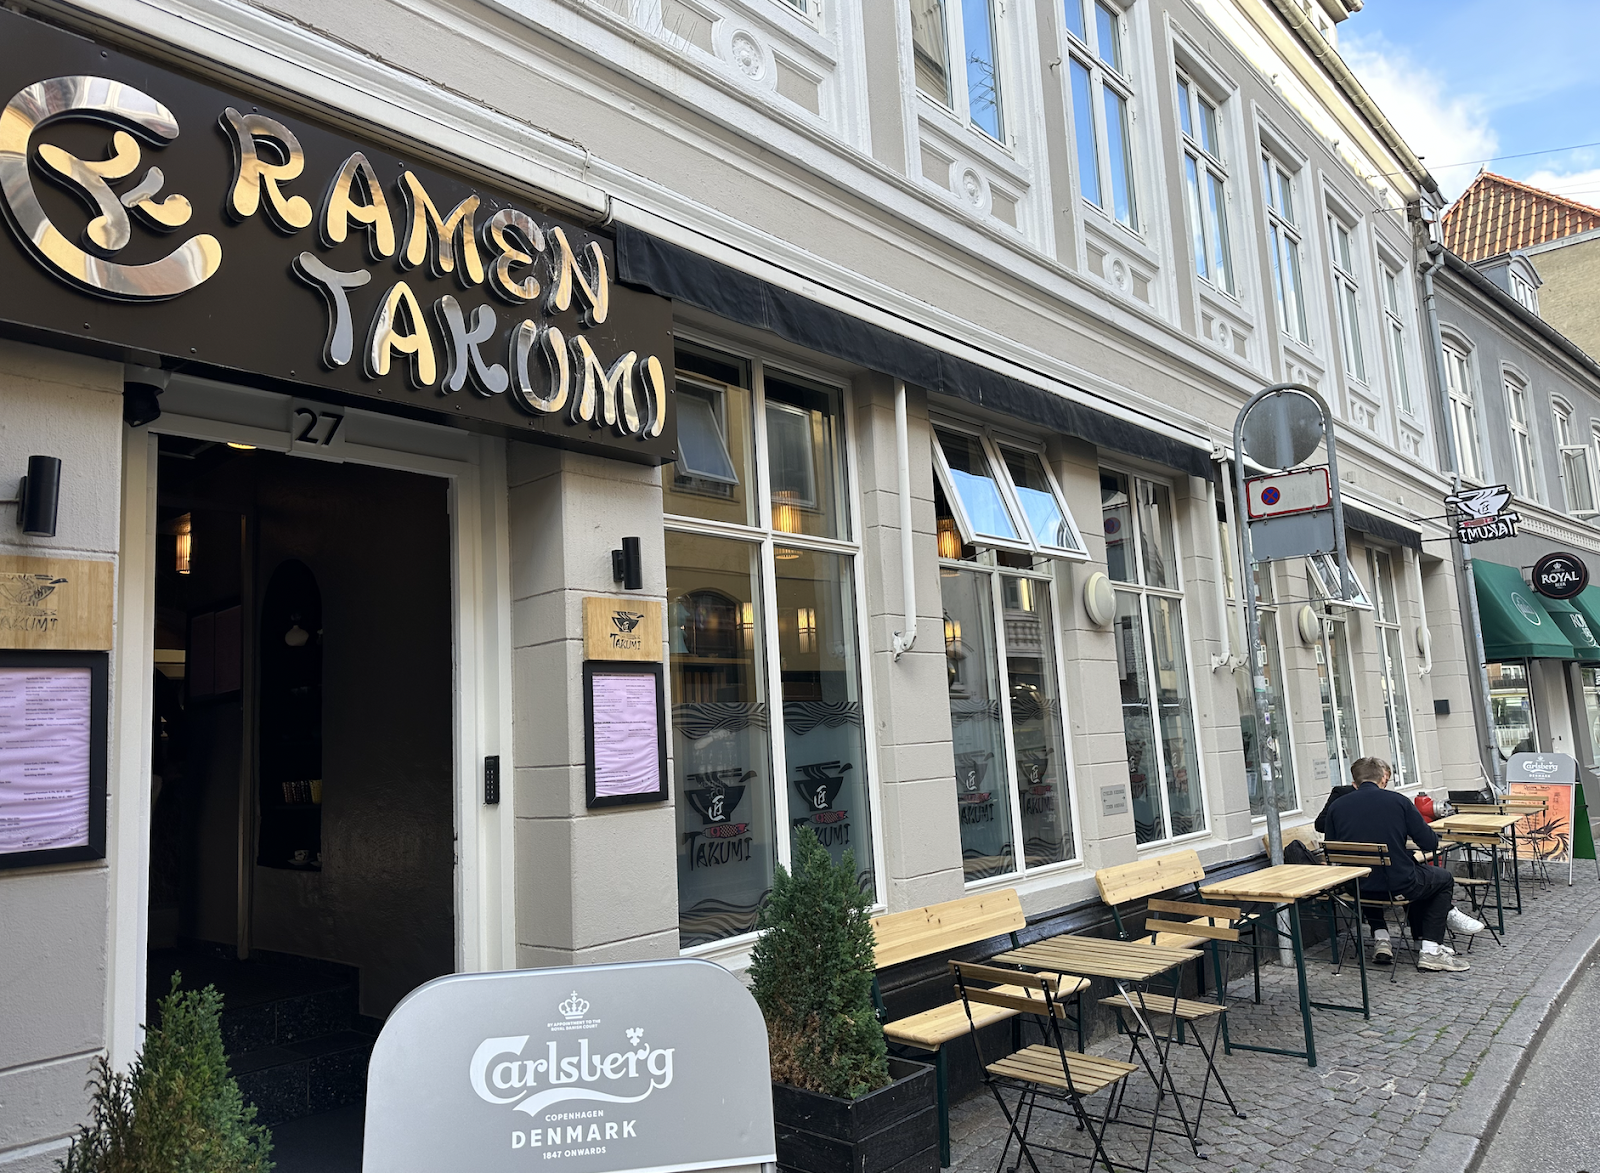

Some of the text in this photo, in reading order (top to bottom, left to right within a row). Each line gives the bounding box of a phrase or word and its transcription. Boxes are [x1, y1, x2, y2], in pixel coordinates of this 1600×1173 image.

[217, 107, 609, 328] RAMEN
[292, 251, 666, 440] TAKUMI
[294, 407, 344, 446] 27
[1541, 570, 1580, 585] ROYAL
[0, 615, 58, 632] AKUMI
[610, 633, 641, 650] TAKUMI
[1523, 761, 1558, 773] Carlsberg
[961, 803, 994, 825] AKUMI
[682, 831, 752, 871] TAKUMI
[469, 1034, 675, 1105] Carlsberg
[545, 1109, 604, 1122] COPENHAGEN
[511, 1119, 637, 1149] DENMARK
[542, 1146, 606, 1160] 1847 ONWARDS
